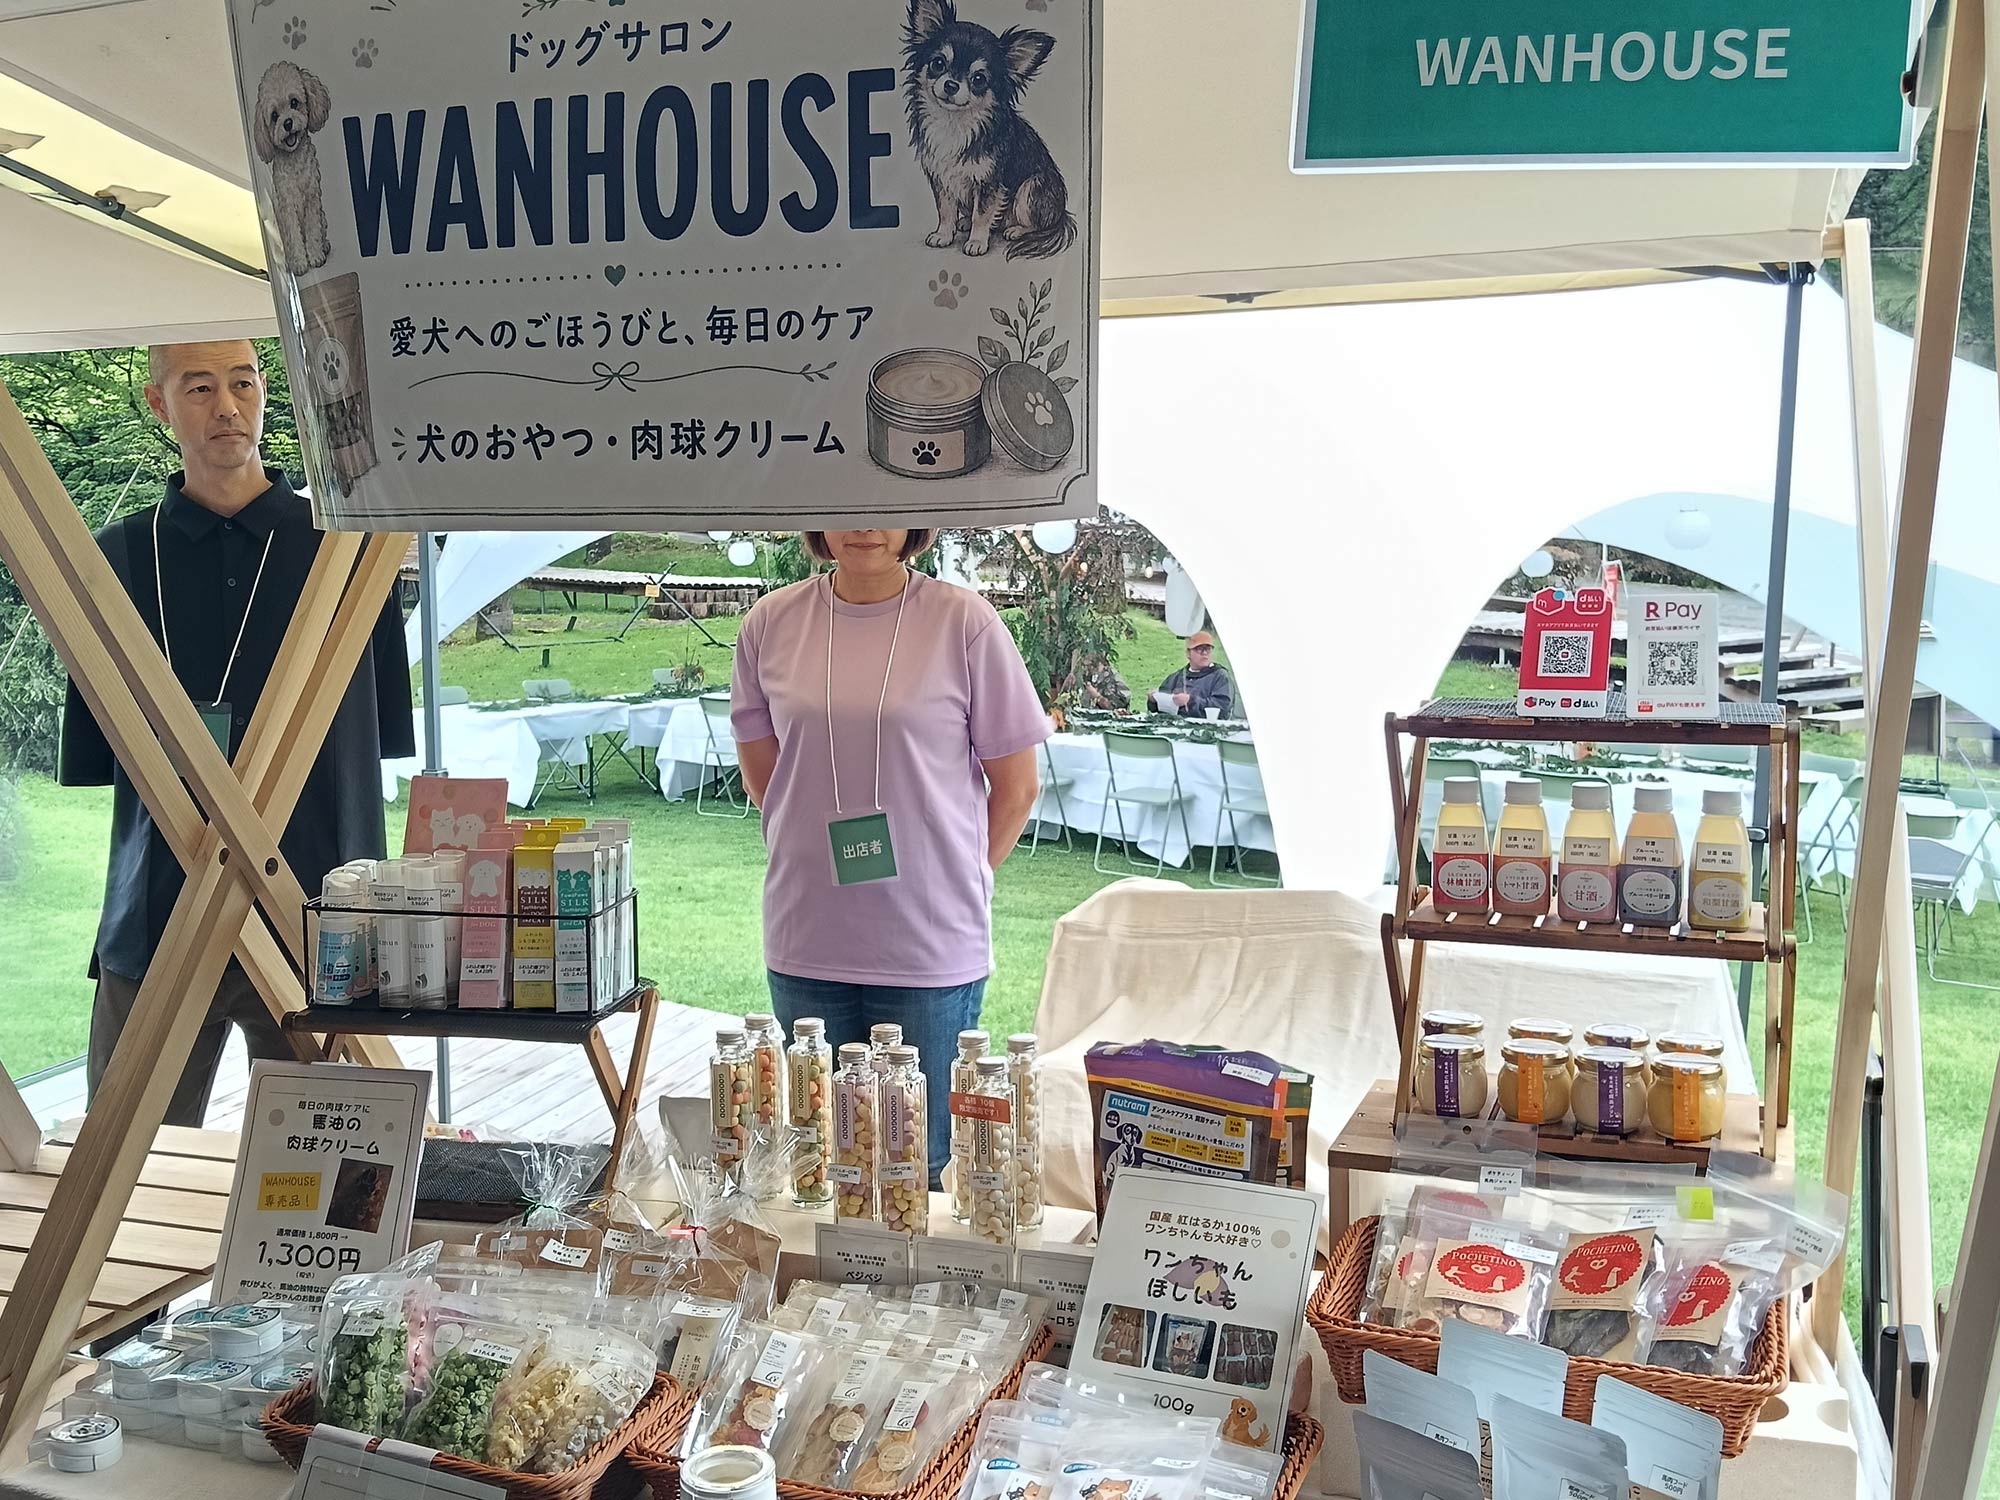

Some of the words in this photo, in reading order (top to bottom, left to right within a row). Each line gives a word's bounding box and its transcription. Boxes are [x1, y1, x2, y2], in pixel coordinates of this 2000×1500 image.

[508, 18, 732, 73] ドッグサロン
[1415, 28, 1790, 86] WANHOUSE
[342, 68, 901, 258] WANHOUSE
[390, 304, 874, 359] 愛犬へのごほうびと、毎日のケア
[415, 420, 845, 464] 犬のおやつ・肉球クリーム
[1665, 602, 1702, 620] Pay
[1538, 699, 1556, 709] Pay
[1573, 698, 1599, 708] d払い
[843, 839, 882, 859] 出店者
[520, 896, 548, 904] SILK
[1573, 890, 1598, 902] 甘酒
[298, 1101, 370, 1113] 毎日の肉球ケアに
[1111, 1097, 1146, 1112] nutram
[313, 1114, 361, 1131] 馬油の
[287, 1135, 379, 1155] 肉球クリーム
[265, 1176, 316, 1186] WANHOUSE
[1150, 1211, 1172, 1223] 国産
[1177, 1214, 1261, 1236] 紅はるか100%
[308, 1231, 338, 1240] 1,800円
[258, 1240, 361, 1272] 1,300円
[1576, 1242, 1636, 1258] POCHETINO
[1144, 1249, 1253, 1281] ワンちゃん
[1452, 1251, 1517, 1268] POCHETINO
[846, 1271, 883, 1283] ベジベジ
[1148, 1278, 1237, 1311] ほしいも
[1056, 1300, 1077, 1312] 山羊
[1153, 1394, 1195, 1415] 100g
[1664, 1484, 1684, 1495] 500円
